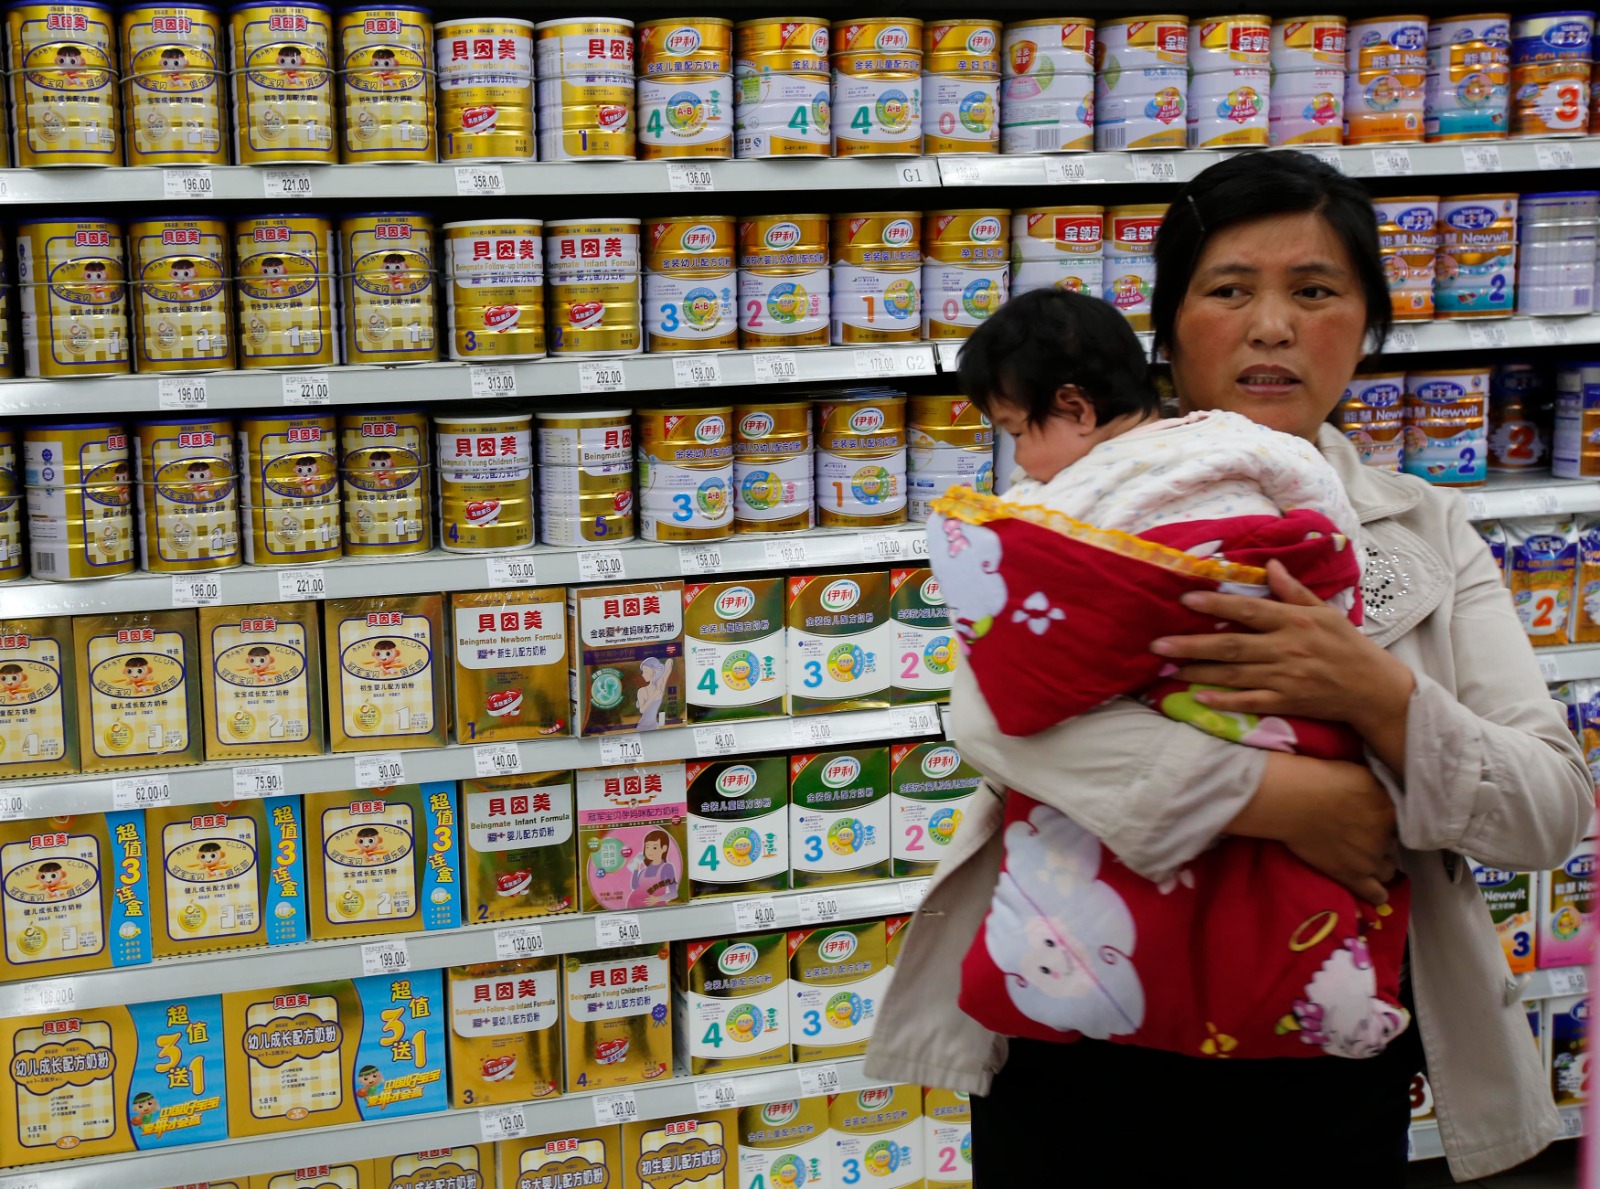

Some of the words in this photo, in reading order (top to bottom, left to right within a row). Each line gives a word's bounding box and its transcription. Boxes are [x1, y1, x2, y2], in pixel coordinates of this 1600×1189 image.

[670, 35, 695, 48] 伊利
[881, 35, 904, 45] 伊利
[972, 36, 992, 46] 伊利
[452, 39, 516, 60] 貝因美
[648, 61, 720, 72] 金装儿童配方奶粉
[1555, 86, 1580, 121] 3
[903, 169, 922, 182] G1
[1061, 164, 1084, 177] 165.00
[1151, 163, 1173, 176] 206.00
[473, 175, 500, 188] 358.00
[686, 172, 711, 184] 136.00
[183, 179, 210, 191] 196.00
[282, 179, 310, 191] 221.00
[770, 230, 794, 241] 伊利
[888, 228, 910, 239] 伊利
[975, 225, 996, 235] 伊利
[686, 233, 711, 244] 伊利
[1462, 232, 1509, 244] Newwit
[473, 240, 534, 261] 貝因美
[560, 238, 621, 259] 貝因美
[1489, 274, 1505, 301] 2
[771, 362, 794, 375] 168.00
[906, 356, 926, 371] G2
[596, 371, 621, 384] 292.00
[690, 368, 715, 380] 158.00
[488, 376, 513, 389] 313.00
[177, 387, 205, 401] 196.00
[301, 384, 328, 397] 221.00
[1431, 405, 1478, 418] Newwit
[744, 421, 767, 431] 伊利
[855, 416, 878, 426] 伊利
[700, 424, 721, 437] 伊利
[455, 436, 517, 457] 貝因美
[467, 458, 487, 466] Young
[1458, 448, 1476, 474] 2
[595, 516, 608, 536] 5
[877, 541, 900, 554] 178.00
[595, 559, 621, 572] 303.00
[695, 553, 720, 566] 158.00
[508, 563, 534, 576] 303.00
[190, 584, 217, 597] 196.00
[296, 580, 324, 592] 221.00
[826, 589, 852, 602] 伊利
[604, 596, 660, 619] 貝因美
[1532, 596, 1554, 627] 2
[478, 611, 543, 633] 貝因美
[700, 620, 770, 634] 金装儿童配方奶粉
[806, 614, 873, 627] 金装幼儿配方奶粉
[460, 637, 497, 646] Beingmate
[500, 635, 531, 644] Newborn
[535, 633, 562, 642] Formula
[901, 652, 920, 678] 2
[803, 660, 823, 688] 3
[697, 668, 718, 695] 4
[811, 725, 830, 737] 53.00
[715, 734, 735, 747] 48.00
[619, 744, 641, 757] 77.10
[492, 753, 517, 768] 140.00
[928, 756, 953, 769] 伊利
[378, 763, 401, 778] 90.00
[827, 766, 853, 779] 伊利
[604, 774, 662, 797] 貝因美
[806, 787, 874, 803] 金装幼儿配方奶粉
[489, 793, 551, 816] 貝因美
[701, 797, 772, 813] 金装儿童配方奶粉
[471, 819, 511, 829] Beingmate
[515, 816, 537, 826] Infant
[540, 813, 570, 823] Formula
[905, 825, 925, 851] 2
[804, 835, 824, 862] 3
[697, 845, 719, 871] 4
[817, 900, 837, 914] 53.00
[754, 907, 775, 922] 48.00
[619, 925, 639, 938] 64.00
[824, 940, 850, 952] 伊利
[1513, 931, 1531, 957] 3
[380, 952, 405, 966] 199.00
[725, 952, 751, 964] 伊利
[589, 964, 648, 988] 貝因美
[805, 961, 872, 978] 金装幼儿配方奶粉
[704, 973, 773, 991] 金装儿童配方奶粉
[474, 979, 536, 1003] 貝因美
[602, 989, 620, 997] Young
[621, 986, 644, 995] Children
[516, 1002, 532, 1010] Infant
[803, 1010, 822, 1036] 3
[248, 1025, 337, 1050] 幼儿成长配方奶粉
[702, 1022, 723, 1048] 4
[15, 1052, 110, 1077] 幼儿成长配方奶粉
[818, 1072, 838, 1086] 53.00
[715, 1087, 735, 1102] 48.00
[611, 1101, 636, 1117] 128.00
[499, 1113, 522, 1131] 129.00
[642, 1150, 722, 1175] 初生婴儿配方奶粉
